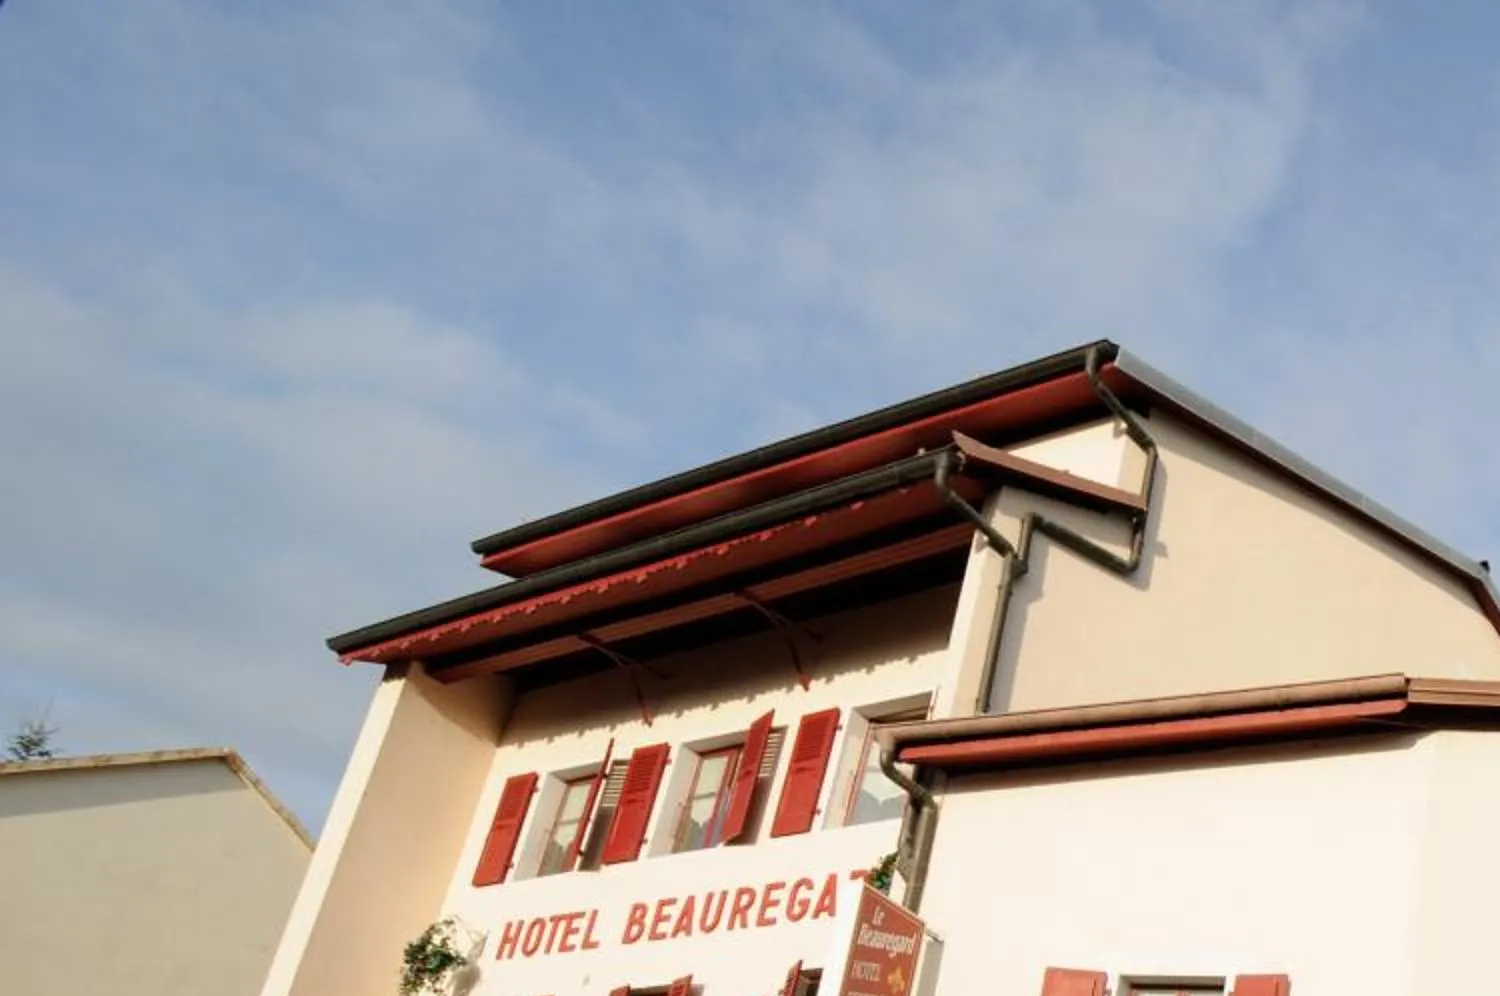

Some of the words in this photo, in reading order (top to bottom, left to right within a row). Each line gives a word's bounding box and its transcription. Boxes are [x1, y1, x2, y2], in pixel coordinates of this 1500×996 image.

[496, 909, 600, 961] HOTEL
[621, 868, 872, 945] BEAUREGA
[850, 959, 881, 982] HOTEL
